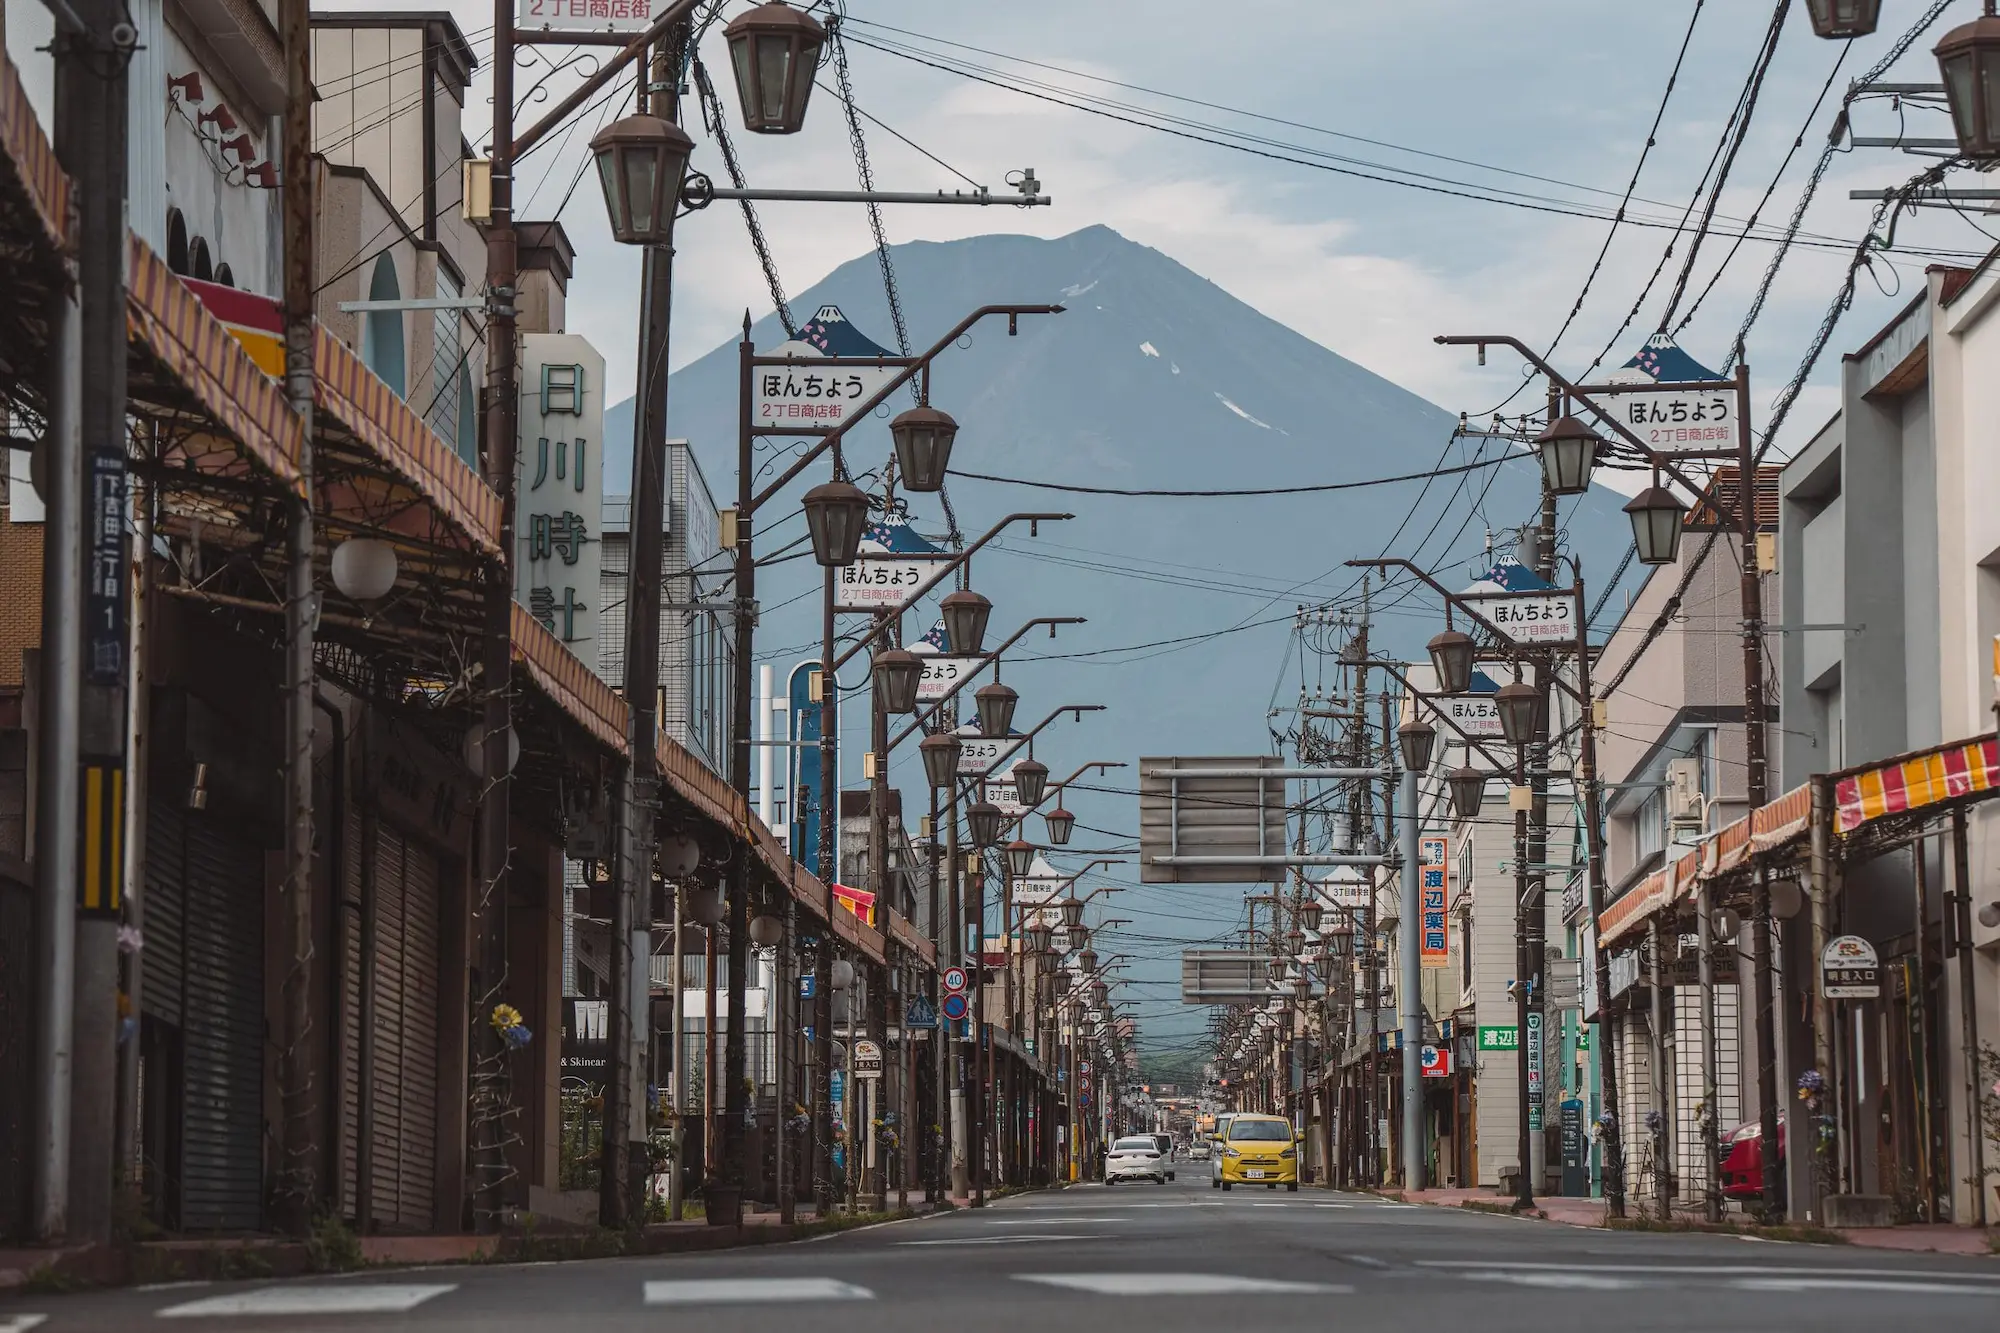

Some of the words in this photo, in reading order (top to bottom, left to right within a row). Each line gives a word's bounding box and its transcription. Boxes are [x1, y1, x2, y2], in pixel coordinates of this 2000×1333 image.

[762, 374, 864, 399] ほんちょう
[762, 403, 843, 419] 2丁目商店街
[1629, 398, 1728, 424] ほんちょう
[1650, 426, 1730, 443] 2丁目商店街
[842, 566, 919, 586] ほんちょう
[841, 588, 904, 601] 2丁目商店街
[1494, 601, 1569, 623] ほんちょう
[1510, 623, 1570, 637] 2丁目商店街
[921, 663, 958, 679] ちょう
[1452, 703, 1499, 718] ほんちょ
[1464, 720, 1502, 731] 2丁目商店
[960, 744, 997, 757] ちょう
[989, 790, 1018, 801] 3丁目商
[1425, 870, 1444, 950] 渡辺薬局
[947, 974, 962, 986] 40
